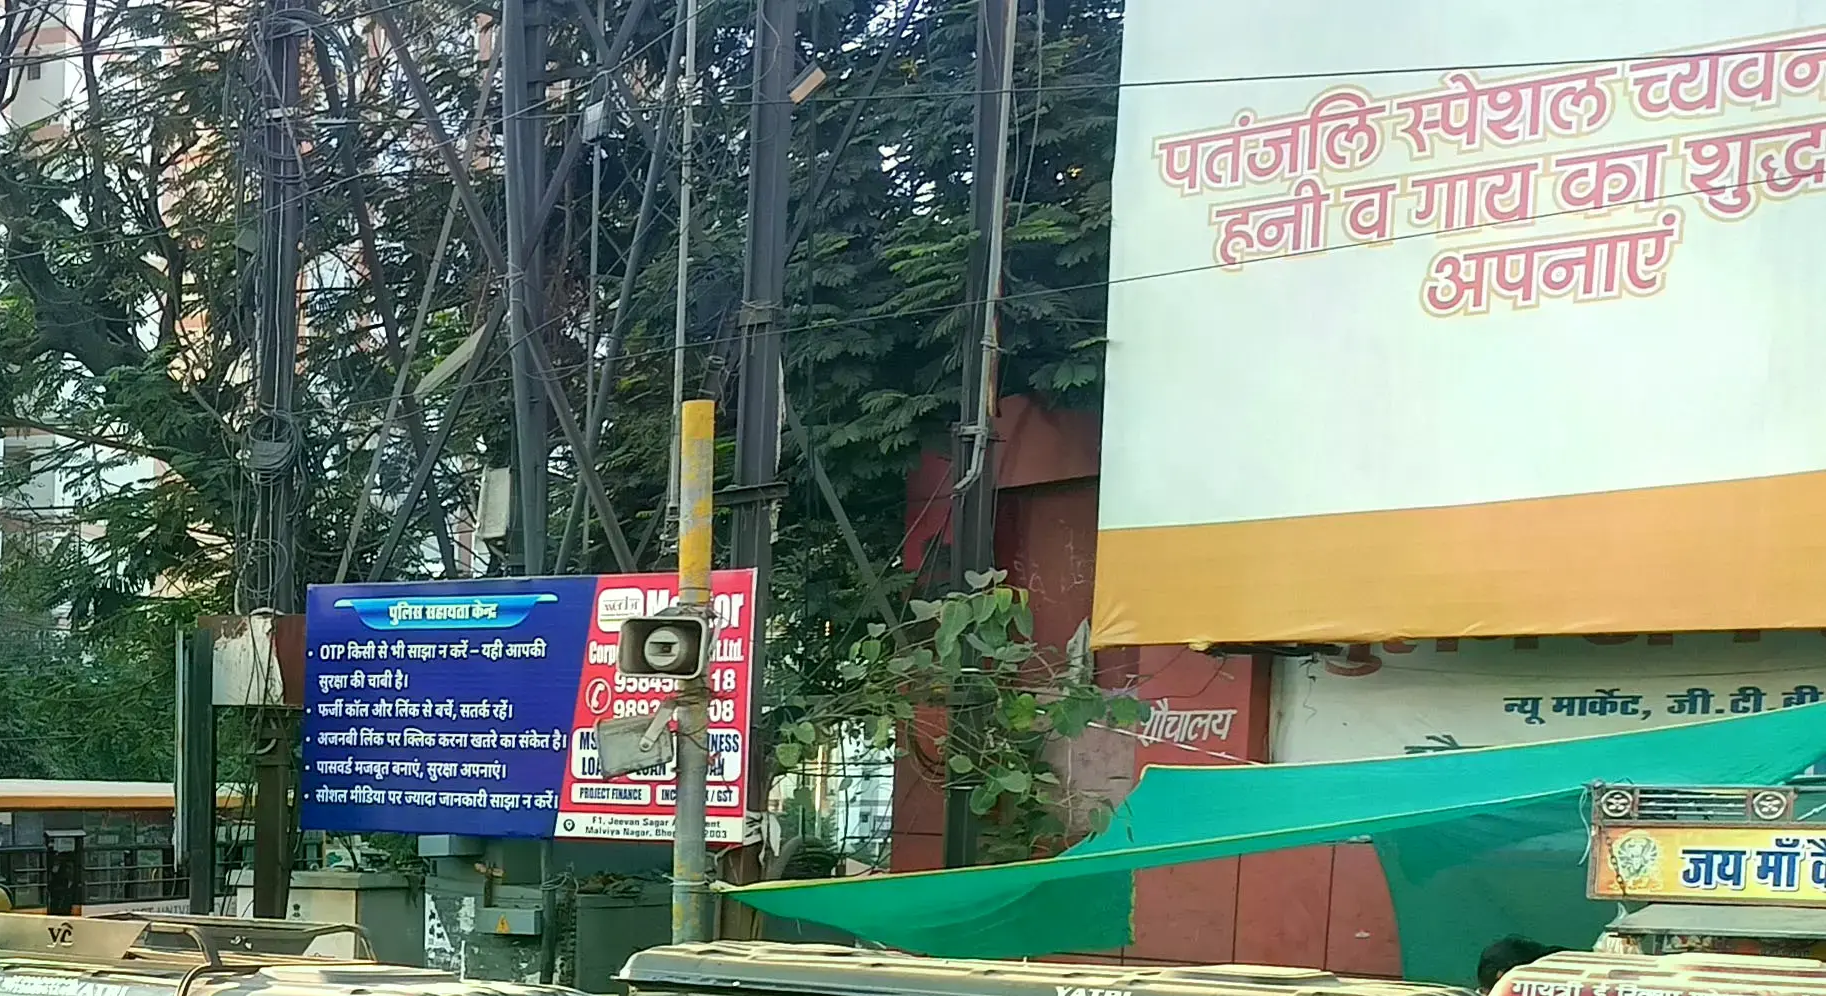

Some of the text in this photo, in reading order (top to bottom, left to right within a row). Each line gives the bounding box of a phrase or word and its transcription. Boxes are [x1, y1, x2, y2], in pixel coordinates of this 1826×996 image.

[1158, 90, 1382, 190] पतंजलि
[1396, 76, 1616, 155] स्पेशल
[1214, 178, 1328, 263] हनी
[1346, 187, 1395, 240] व
[1412, 163, 1537, 231] गाय
[1556, 146, 1666, 209] का
[1428, 215, 1678, 312] अपनाएं
[387, 601, 423, 626] पुलिस
[425, 602, 470, 621] सहायता
[319, 642, 346, 661] OTP
[347, 640, 376, 660] किसी
[377, 640, 390, 660] से
[390, 640, 405, 659] भी
[407, 643, 436, 661] साझा
[438, 643, 447, 659] न
[449, 639, 469, 659] करें
[481, 639, 503, 659] यही
[505, 637, 547, 658] आपकी
[318, 673, 349, 693] सुरक्षा
[350, 669, 365, 688] की
[367, 669, 392, 689] चाबी
[318, 699, 343, 717] फर्जी
[344, 699, 368, 717] कॉल
[371, 698, 393, 717] और
[395, 698, 420, 717] लिंक
[422, 700, 433, 718] से
[459, 700, 490, 718] सतर्क
[1503, 696, 1546, 725] न्यू
[317, 728, 358, 746] अजनबी
[359, 728, 385, 747] लिंक
[387, 732, 401, 746] पर
[403, 728, 437, 747] क्लिक
[438, 733, 468, 748] करना
[470, 730, 498, 748] खतरे
[500, 734, 516, 748] का
[518, 729, 550, 749] संकेत
[316, 757, 352, 775] पासवर्ड
[354, 761, 389, 780] मजबूत
[426, 763, 457, 782] सुरक्षा
[315, 784, 347, 803] सोशल
[349, 785, 385, 804] मीडिया
[388, 790, 402, 805] पर
[404, 790, 436, 807] ज्यादा
[438, 788, 487, 808] जानकारी
[489, 793, 520, 811] साझा
[522, 794, 532, 808] न
[579, 786, 610, 800] PROJECT
[611, 787, 642, 801] FINANCE
[585, 827, 621, 837] Malviya
[608, 818, 640, 827] Jeevan
[642, 818, 669, 828] Sagar
[1682, 848, 1747, 887] जय
[1755, 837, 1800, 888] माँ
